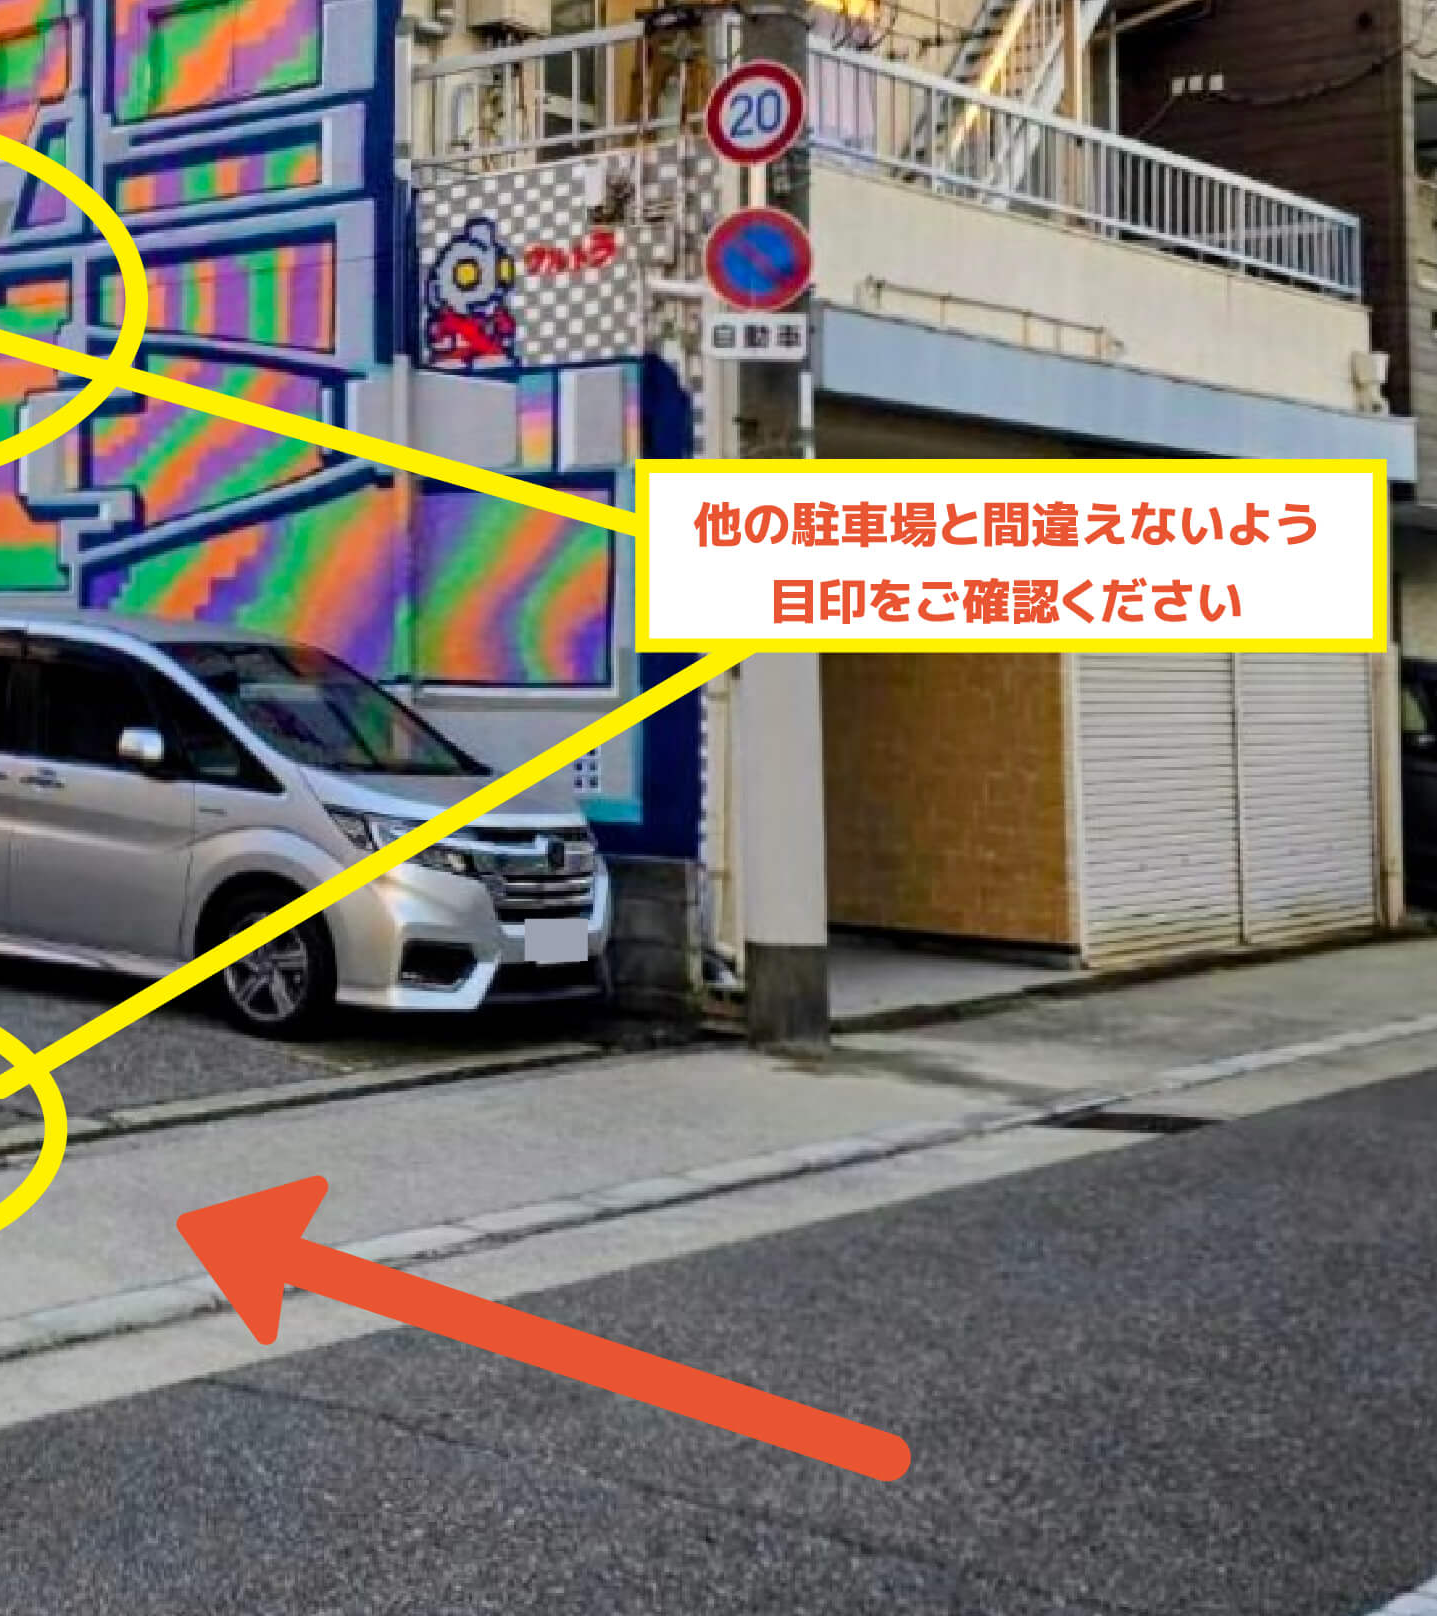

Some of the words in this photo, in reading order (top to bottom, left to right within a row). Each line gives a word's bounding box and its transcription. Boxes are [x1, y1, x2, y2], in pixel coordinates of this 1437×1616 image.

[730, 90, 781, 138] 20
[713, 325, 800, 348] 自動車
